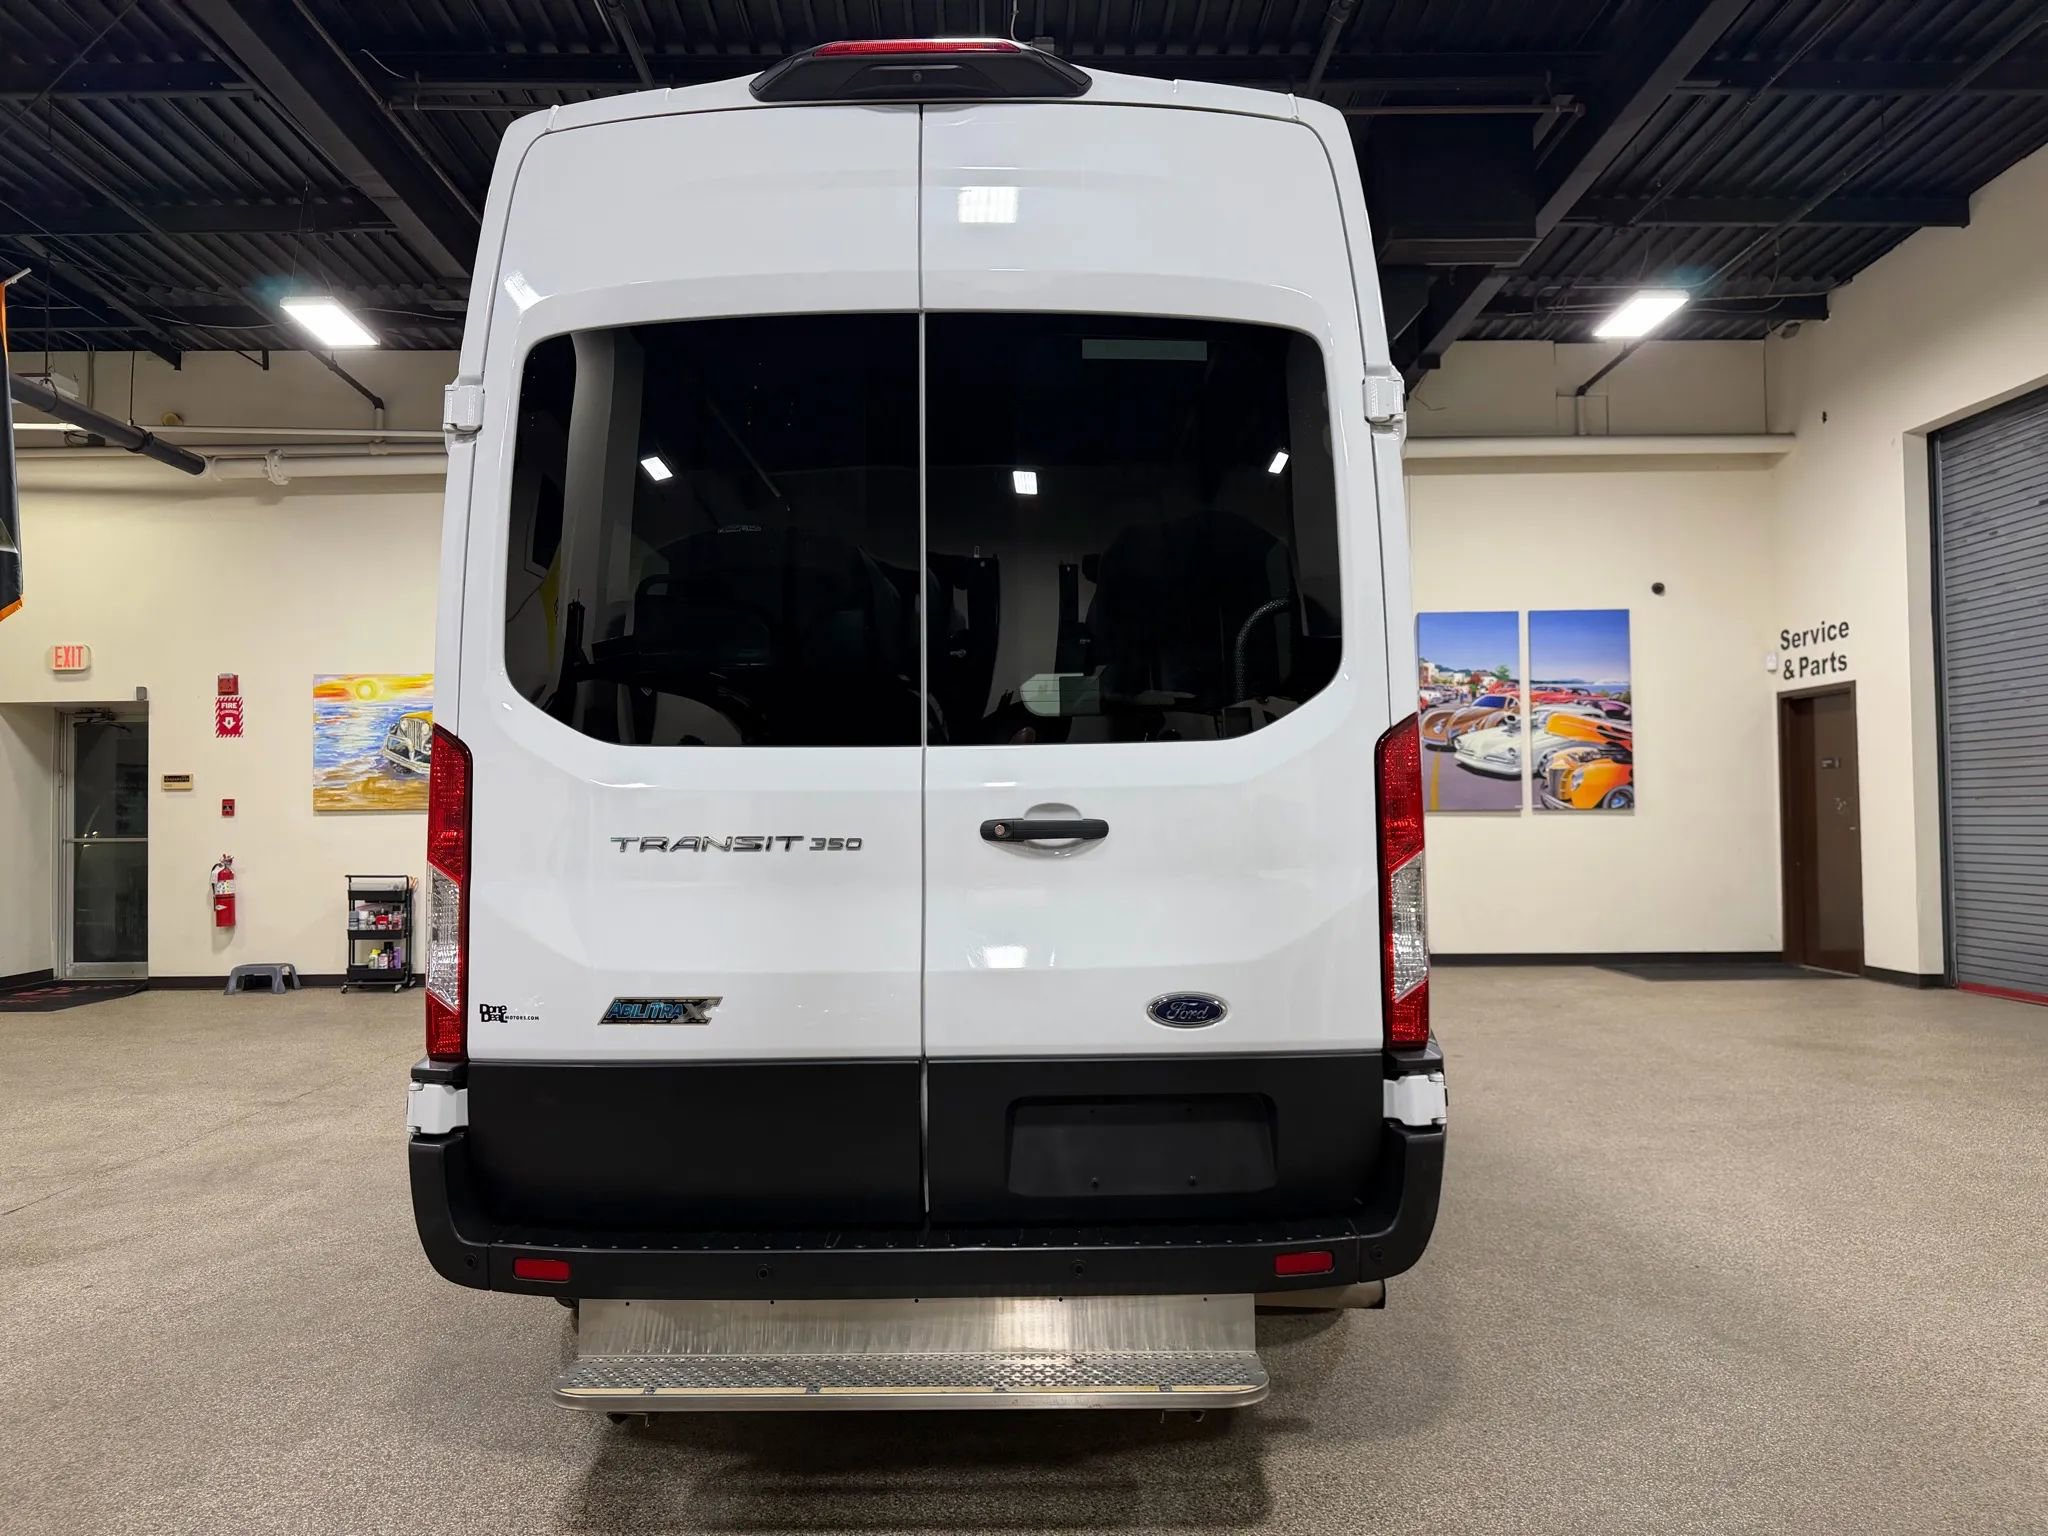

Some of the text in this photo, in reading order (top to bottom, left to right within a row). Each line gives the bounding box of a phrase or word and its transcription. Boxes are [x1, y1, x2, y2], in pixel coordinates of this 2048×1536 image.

[1780, 620, 1849, 651] Service
[54, 645, 84, 668] EXIT
[1783, 651, 1848, 681] & Parts
[610, 836, 863, 853] TRANSIT 350
[479, 1003, 507, 1014] Done
[1166, 1001, 1210, 1019] Ford
